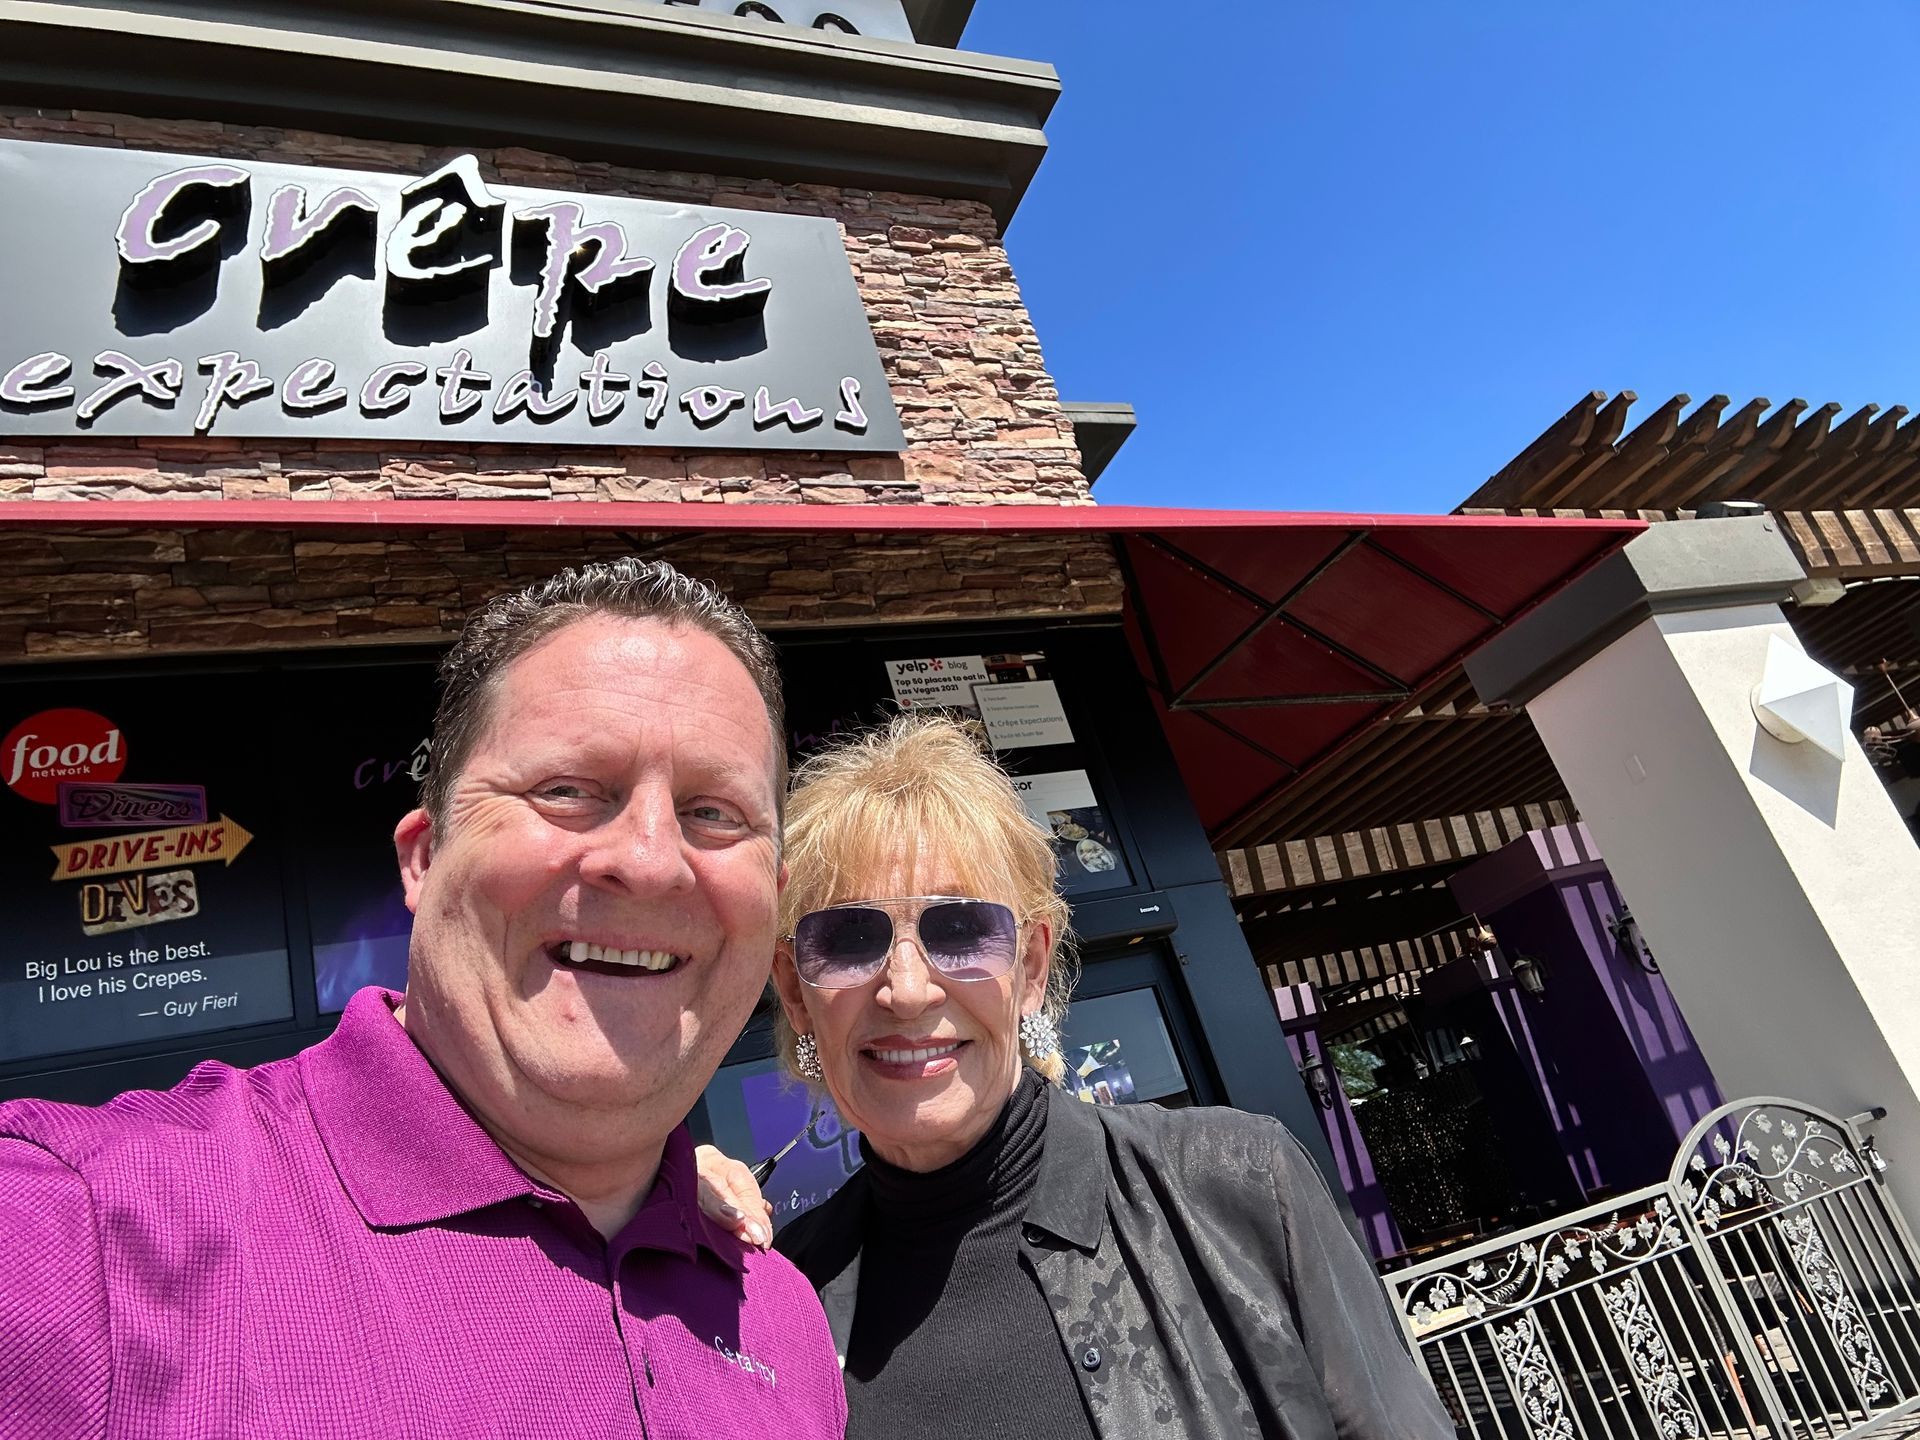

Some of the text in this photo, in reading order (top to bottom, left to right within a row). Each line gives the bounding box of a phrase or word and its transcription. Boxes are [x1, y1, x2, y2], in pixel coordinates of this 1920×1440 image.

[114, 153, 774, 341] crêpe
[0, 348, 869, 437] expectations
[895, 672, 986, 687] Top 50 places to eat in
[896, 660, 968, 675] yelp blog
[897, 683, 959, 695] Las Vegas 2021
[1019, 716, 1064, 726] Expectations
[7, 728, 121, 786] food
[32, 765, 91, 778] network
[353, 738, 433, 790] crê
[69, 788, 194, 820] Diners
[67, 827, 225, 873] DRIVE-INS
[81, 873, 196, 926] DIVES
[25, 941, 212, 981] Big Lou is the best.
[38, 968, 208, 1003] I love his Crepes.
[163, 1001, 198, 1017] Guy
[202, 992, 239, 1012] Fieri
